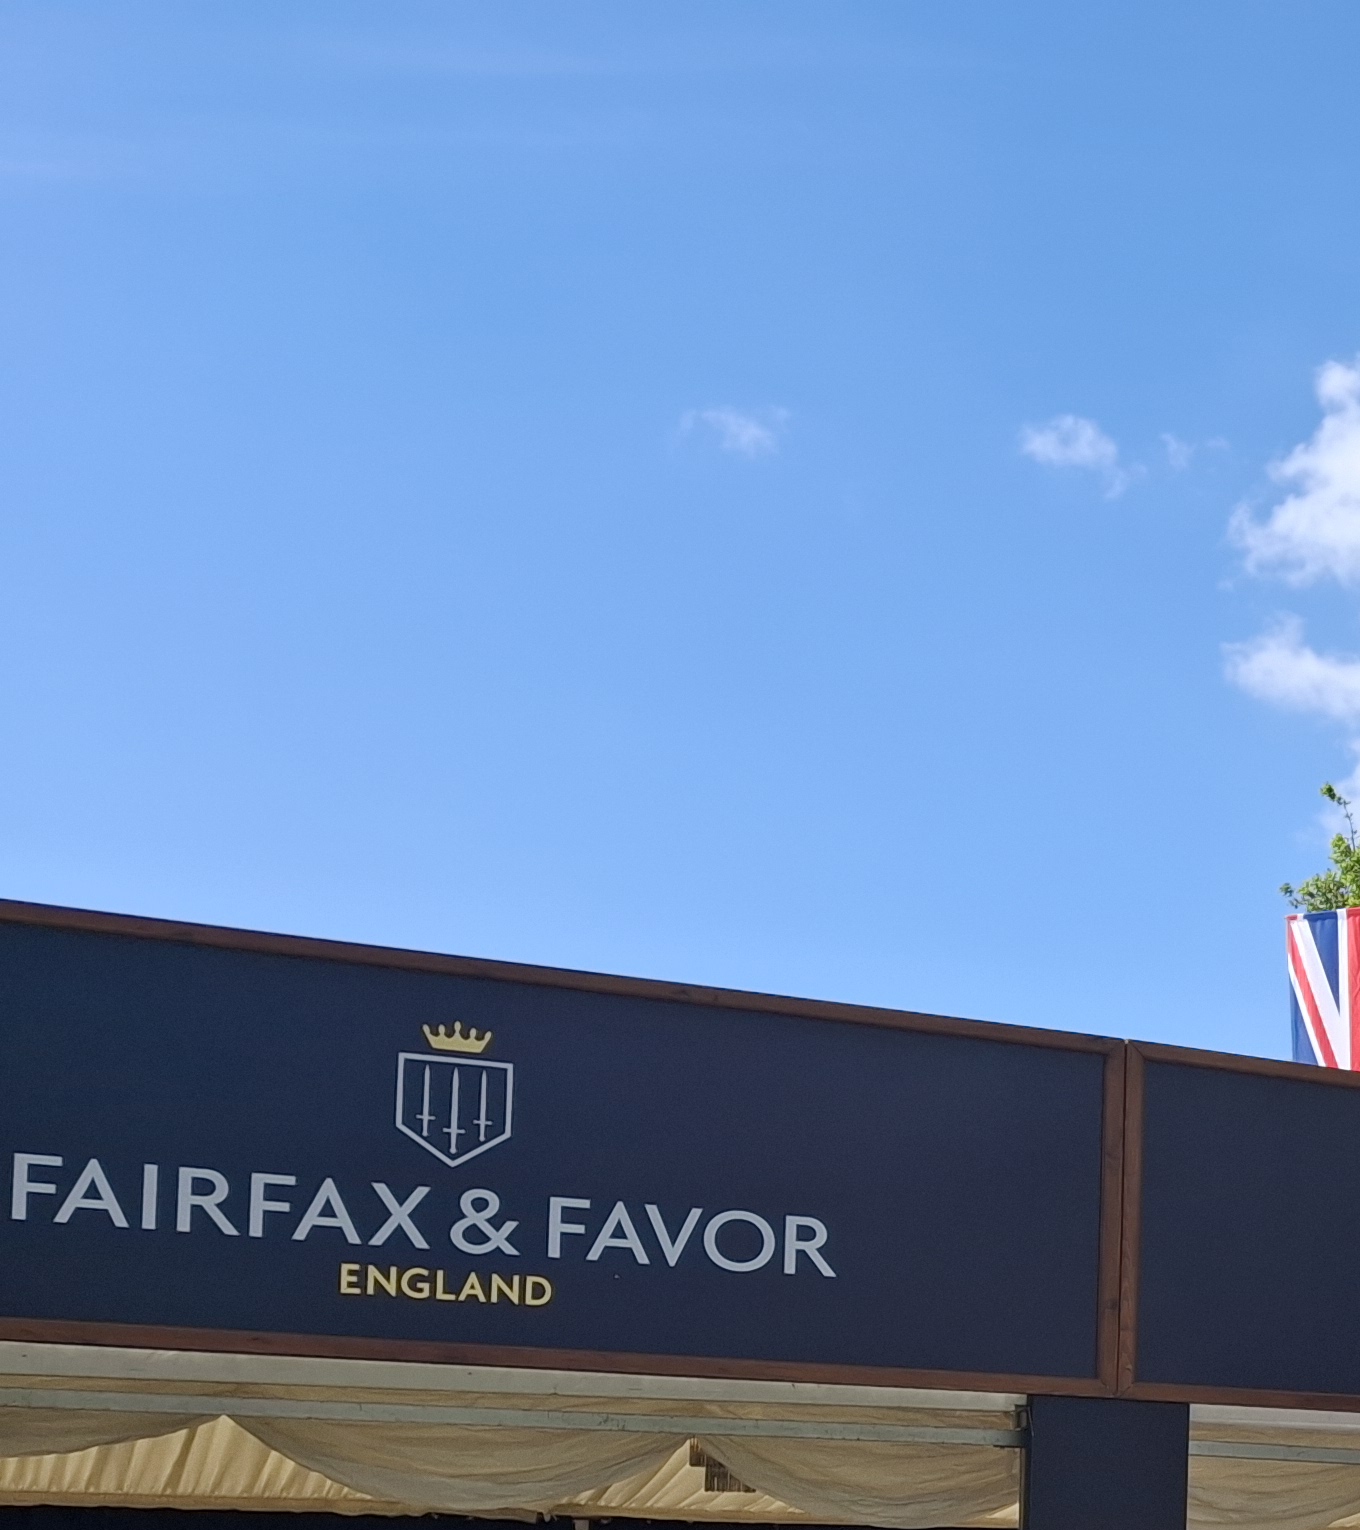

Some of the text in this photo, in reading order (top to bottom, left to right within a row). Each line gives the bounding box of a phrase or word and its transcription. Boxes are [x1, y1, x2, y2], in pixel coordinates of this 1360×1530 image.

[10, 1152, 837, 1278] FAIRFAX & FAVOR
[339, 1263, 552, 1306] ENGLAND
